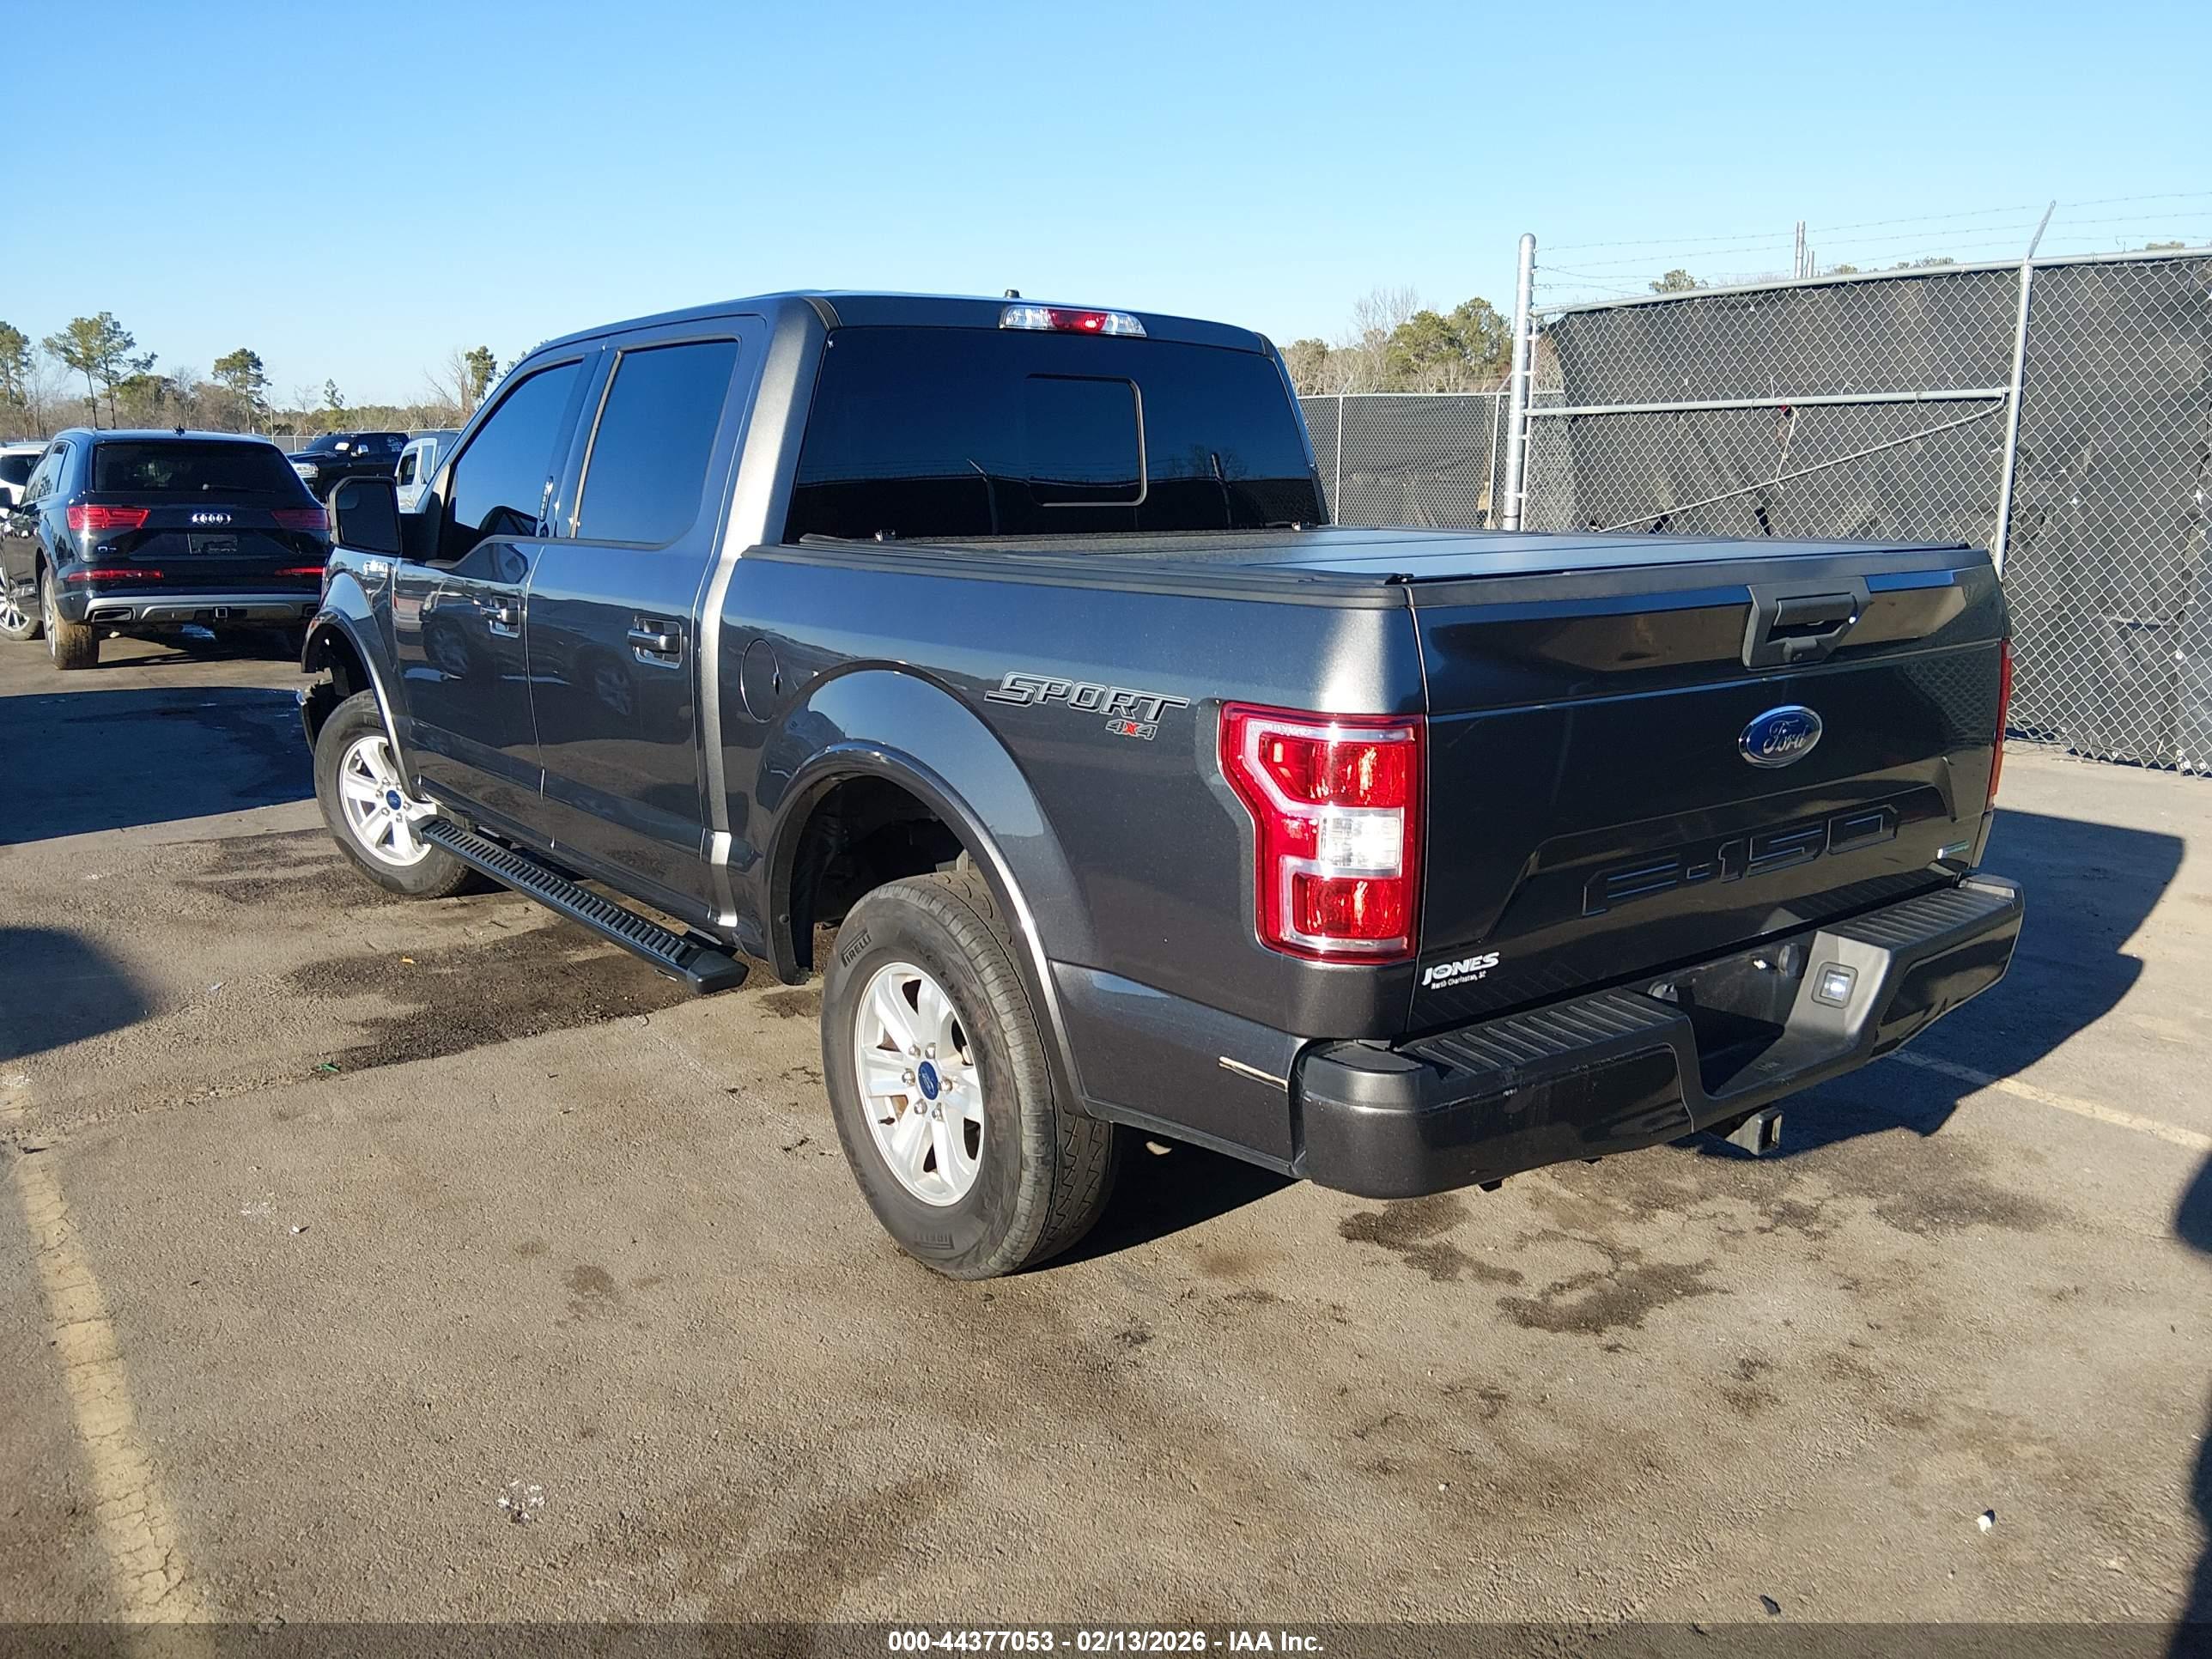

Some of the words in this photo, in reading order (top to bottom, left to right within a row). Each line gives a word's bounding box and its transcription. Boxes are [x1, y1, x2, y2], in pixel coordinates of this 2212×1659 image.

[984, 671, 1191, 723] SPORT
[1762, 719, 1810, 755] Ford
[1581, 803, 1900, 918] F-150
[841, 927, 872, 969] PIRELLI
[1421, 951, 1501, 987] JONES
